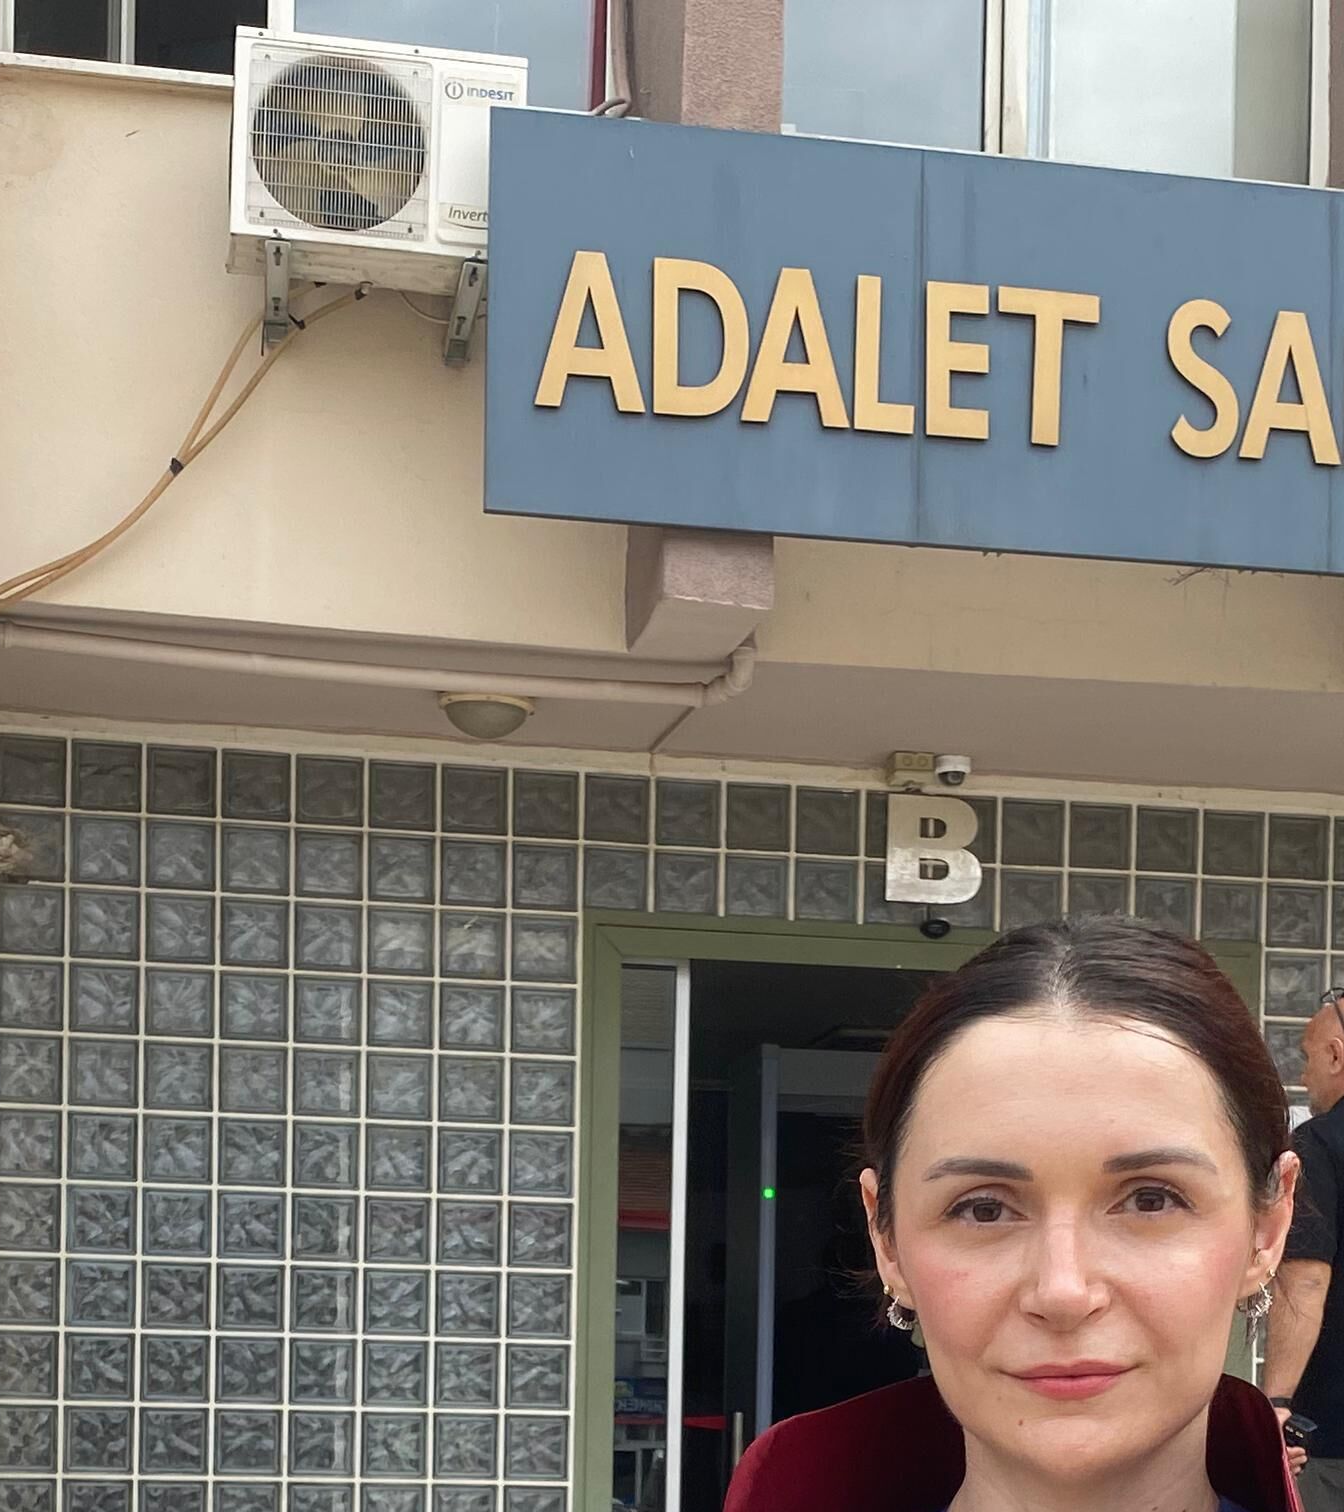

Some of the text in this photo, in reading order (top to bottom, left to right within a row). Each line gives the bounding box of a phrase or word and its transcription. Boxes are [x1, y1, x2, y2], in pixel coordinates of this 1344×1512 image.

[448, 206, 489, 223] Invert
[534, 250, 1100, 447] ADALET
[885, 794, 982, 904] B
